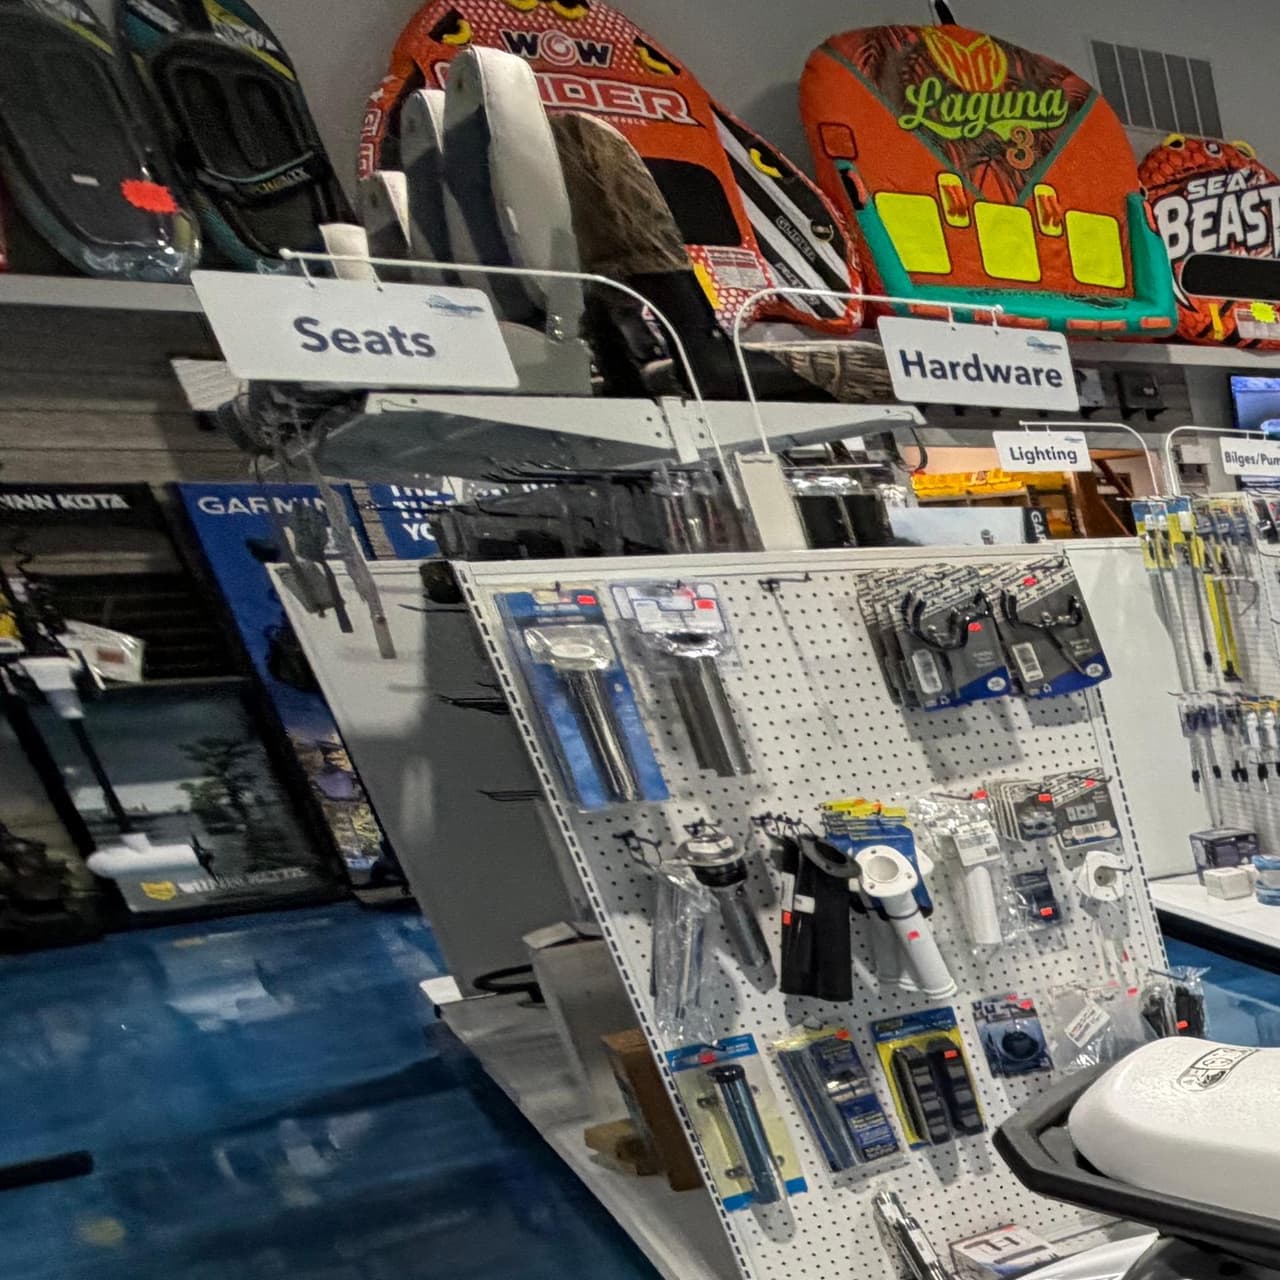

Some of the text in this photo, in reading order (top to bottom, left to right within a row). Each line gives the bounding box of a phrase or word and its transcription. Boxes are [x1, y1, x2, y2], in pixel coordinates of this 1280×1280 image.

[500, 30, 613, 69] WOW
[898, 77, 1069, 142] Laguna
[1006, 126, 1034, 170] 3
[1187, 171, 1250, 200] SEA
[291, 316, 437, 360] Seats
[898, 349, 1064, 390] Hardware
[1009, 445, 1078, 467] Lighting
[0, 493, 130, 512] INN KOTA
